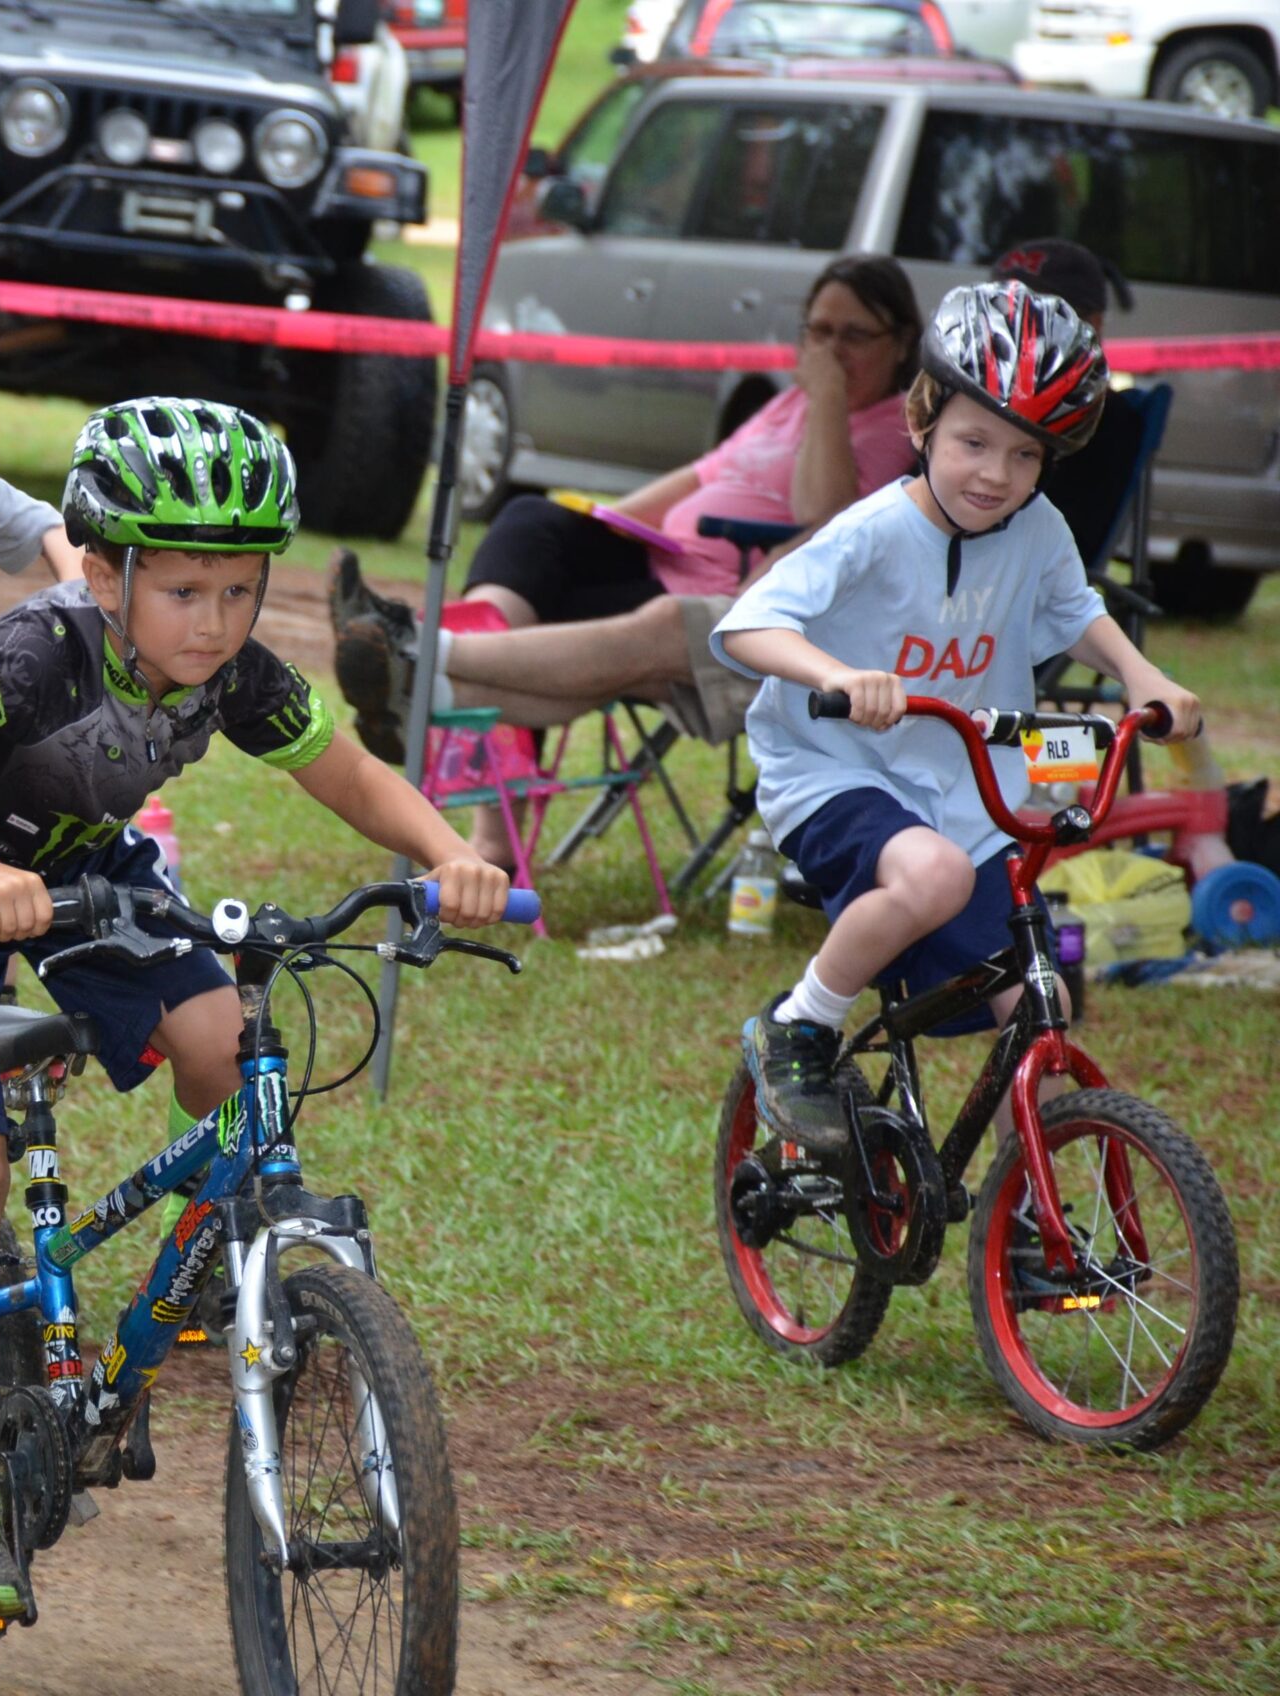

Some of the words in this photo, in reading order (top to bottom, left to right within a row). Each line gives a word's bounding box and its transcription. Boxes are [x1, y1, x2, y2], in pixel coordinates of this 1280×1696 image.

[938, 586, 994, 624] MY
[895, 634, 996, 681] DAD
[1046, 740, 1070, 759] RLB
[148, 1109, 217, 1176] TREK
[165, 1227, 216, 1305] MONSTER
